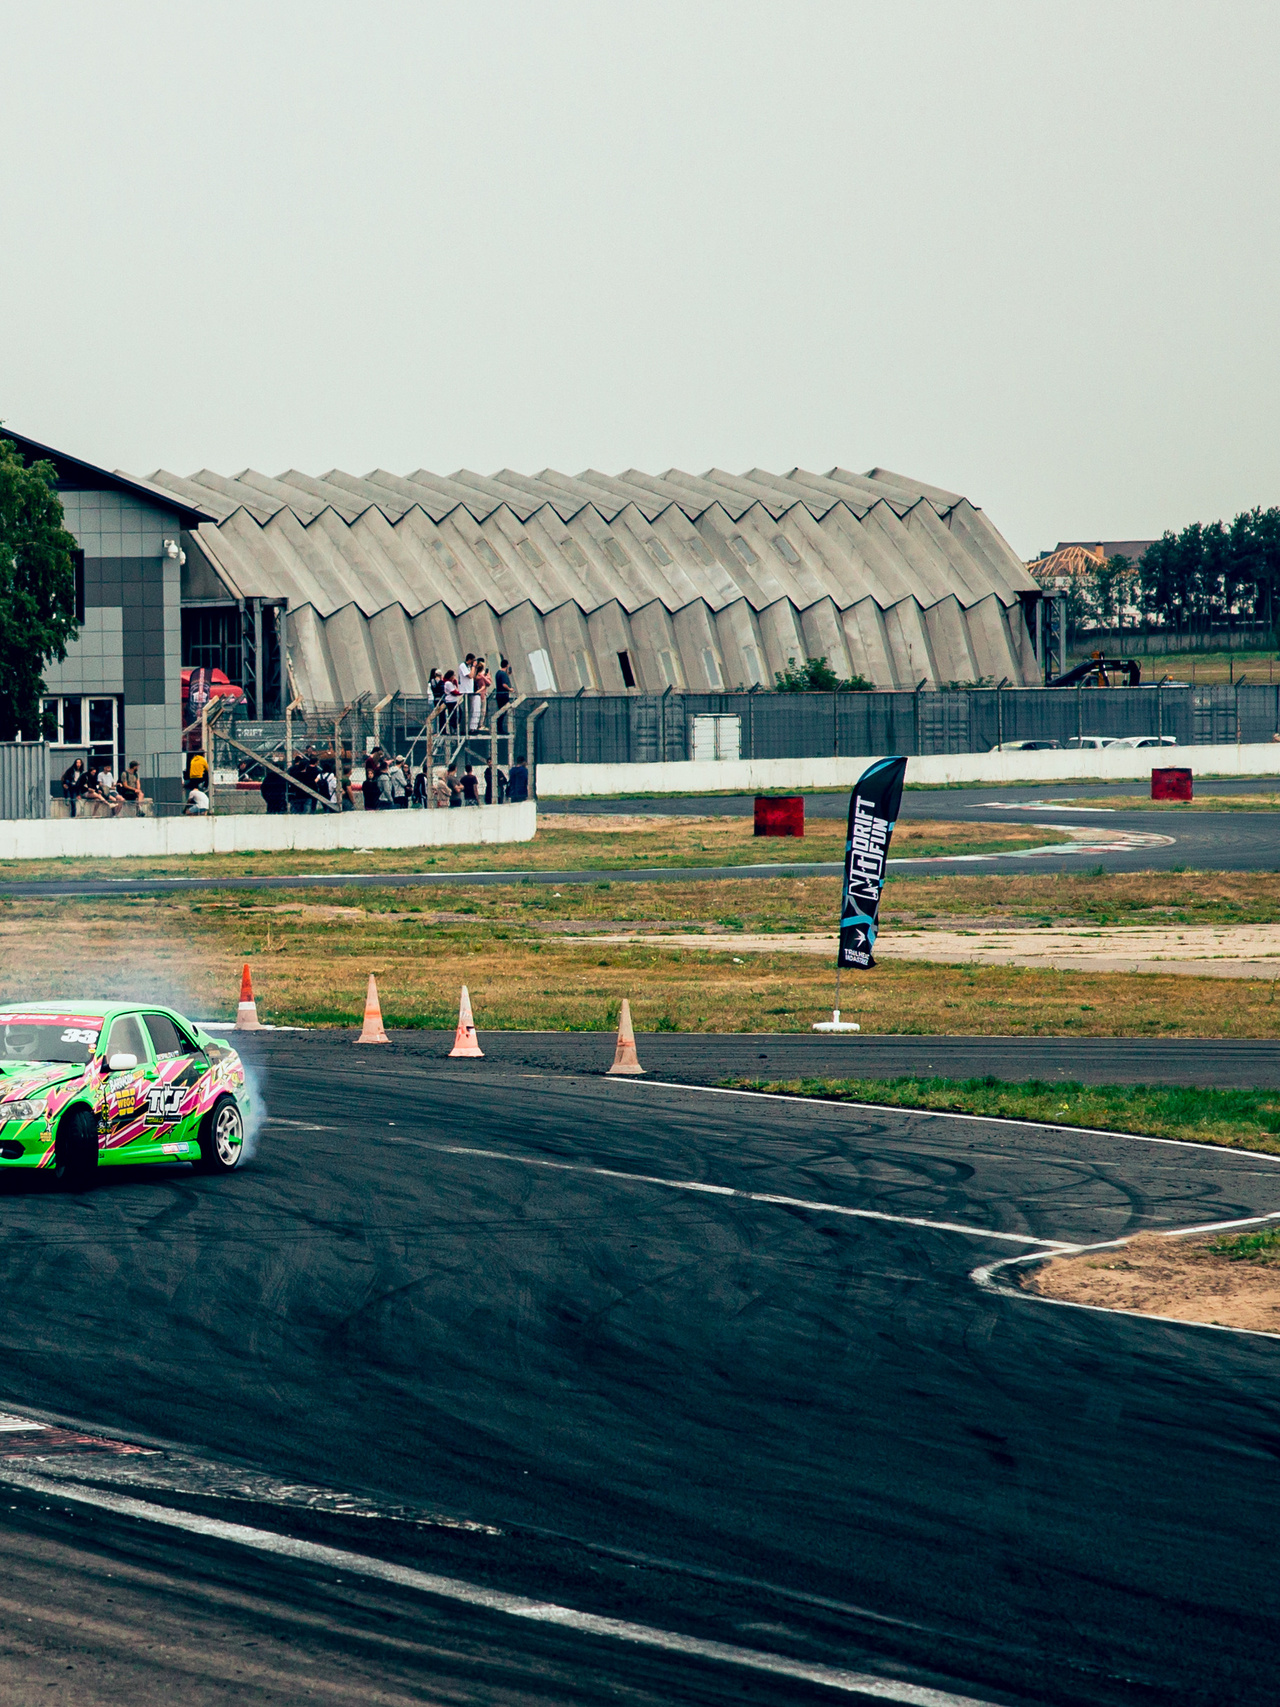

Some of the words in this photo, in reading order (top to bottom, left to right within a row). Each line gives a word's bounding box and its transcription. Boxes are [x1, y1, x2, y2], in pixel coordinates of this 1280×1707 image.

[853, 795, 876, 851] DRIFT
[868, 816, 889, 856] FUN
[60, 1028, 99, 1044] 33
[147, 1089, 186, 1113] TCS
